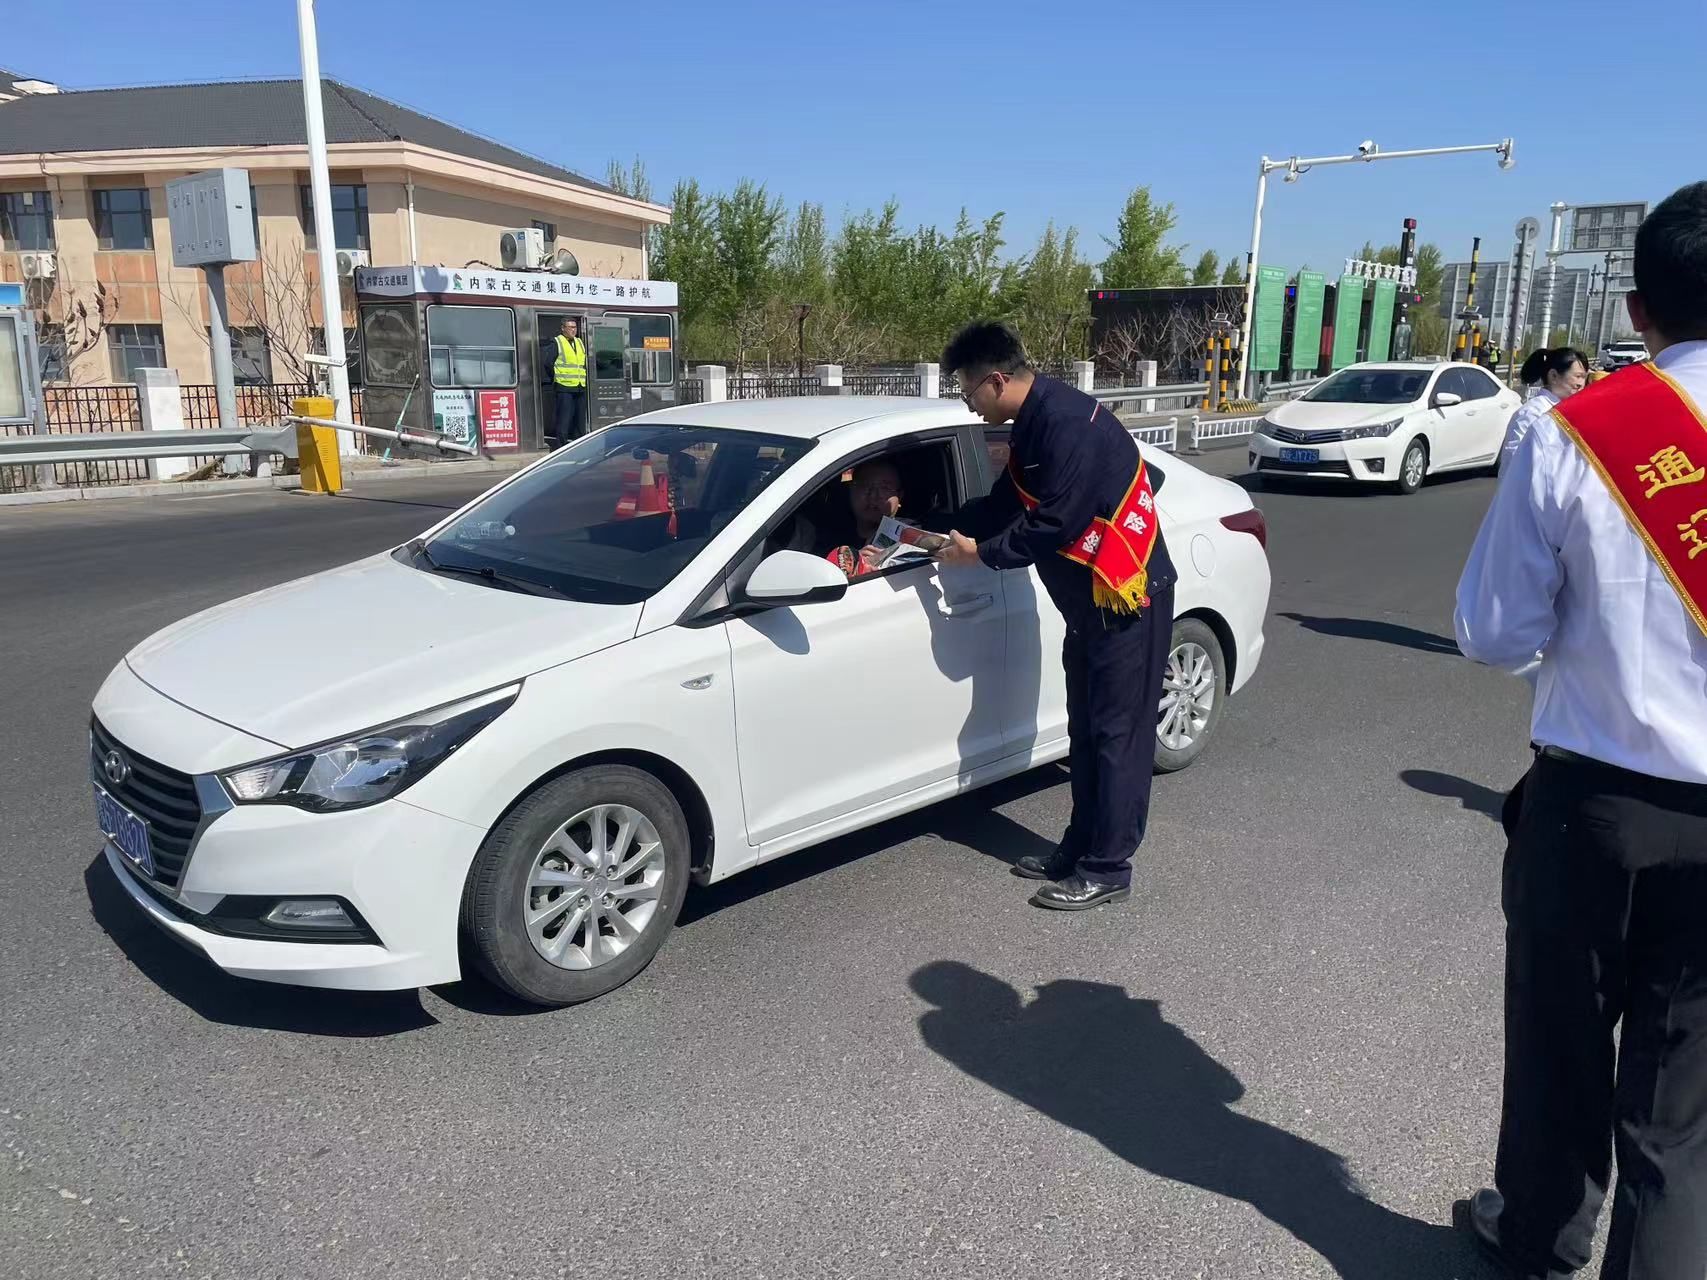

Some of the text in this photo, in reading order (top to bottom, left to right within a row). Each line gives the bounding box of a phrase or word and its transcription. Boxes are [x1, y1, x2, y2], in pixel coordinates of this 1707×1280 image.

[366, 274, 408, 287] 内蒙古交通集团
[469, 276, 651, 299] 内蒙古交通集团为您一路护航
[490, 396, 509, 407] 一停
[490, 408, 509, 418] 二看
[485, 419, 513, 430] 三通过
